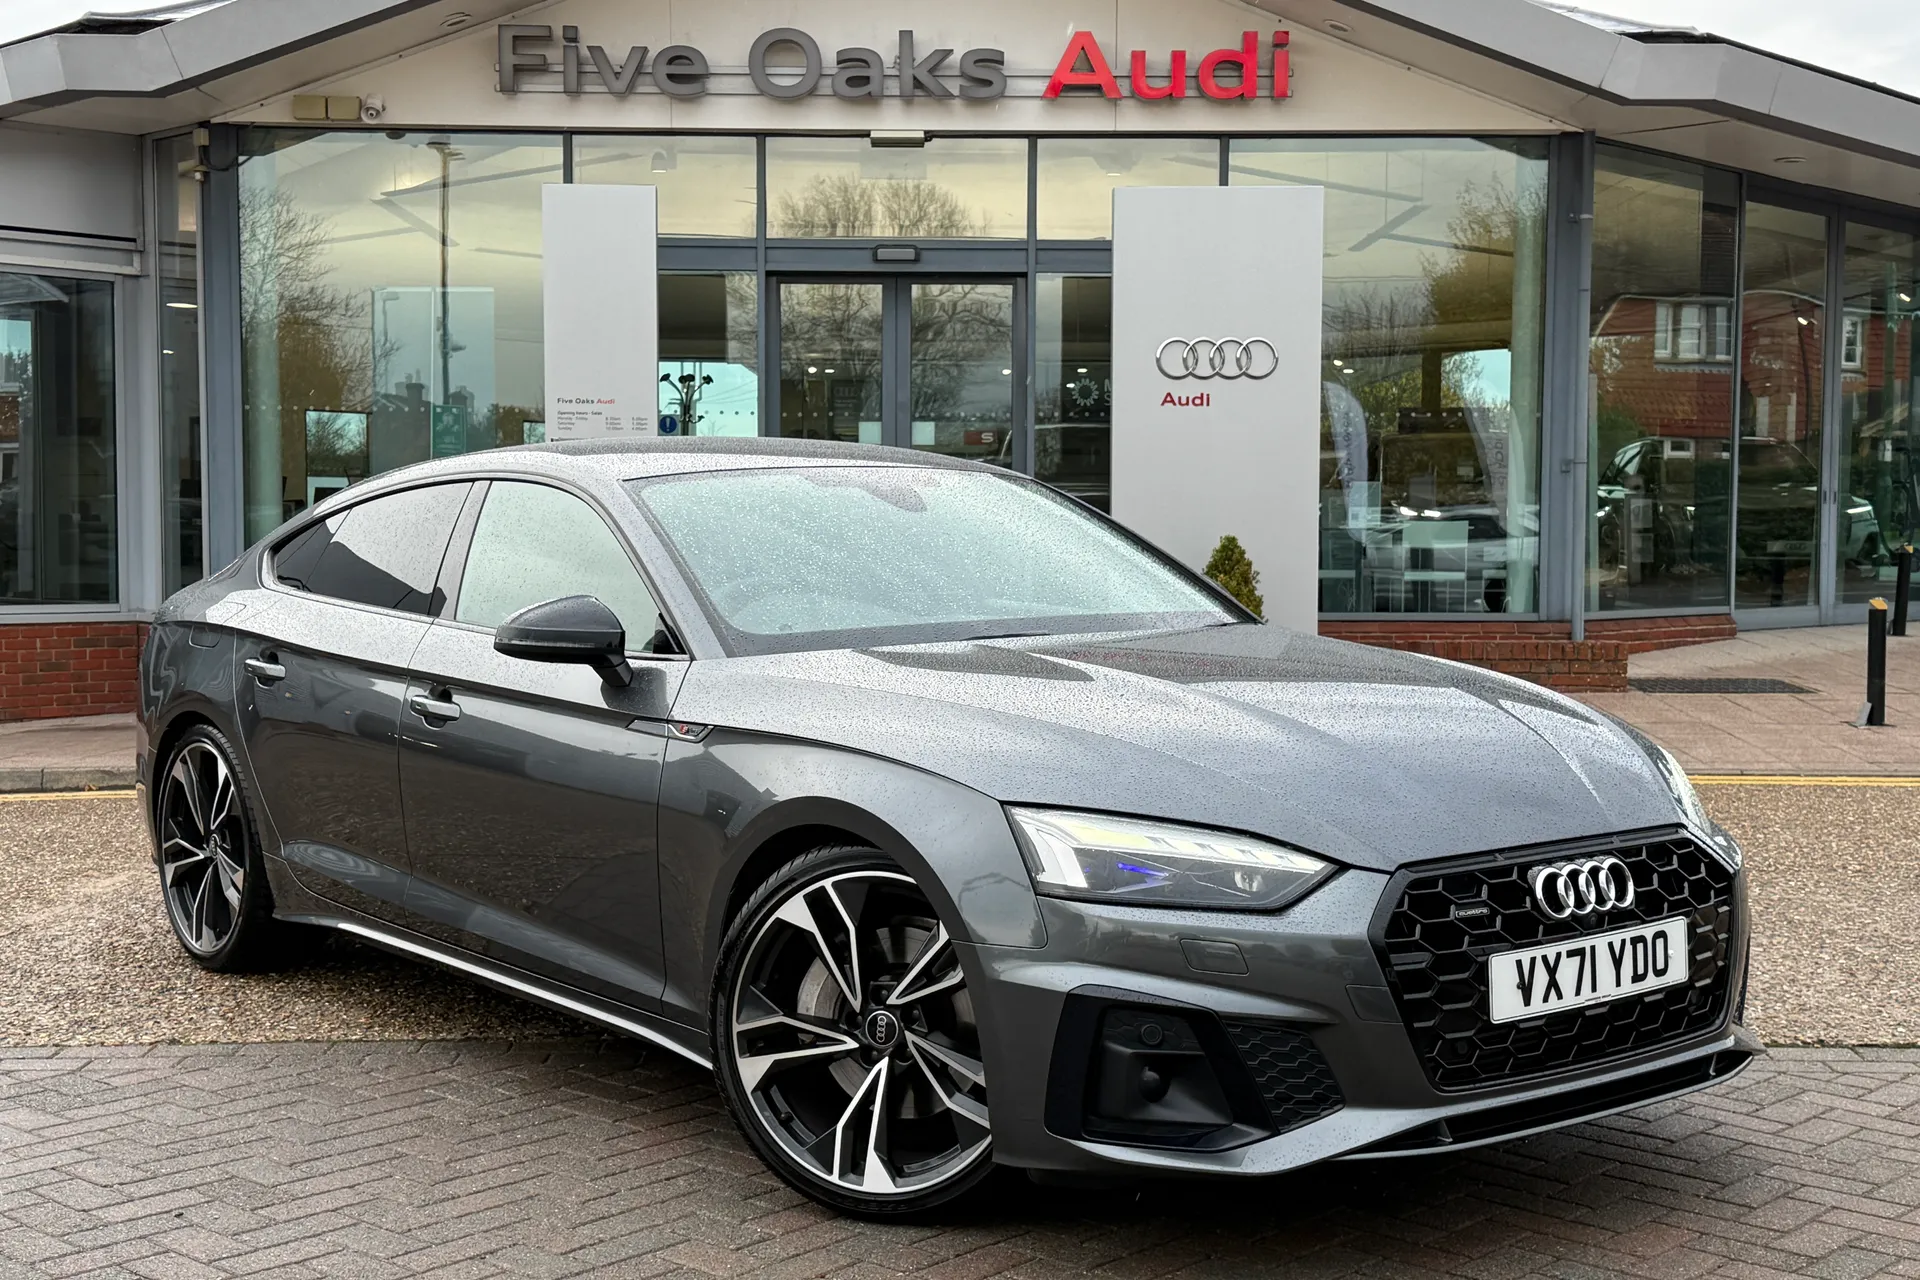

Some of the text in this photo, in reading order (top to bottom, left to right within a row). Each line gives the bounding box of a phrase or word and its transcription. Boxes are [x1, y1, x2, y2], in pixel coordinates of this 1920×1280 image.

[498, 24, 1290, 100] Five Oaks Audi
[1160, 391, 1211, 407] Audi
[1515, 929, 1669, 1008] VX71 YDO
